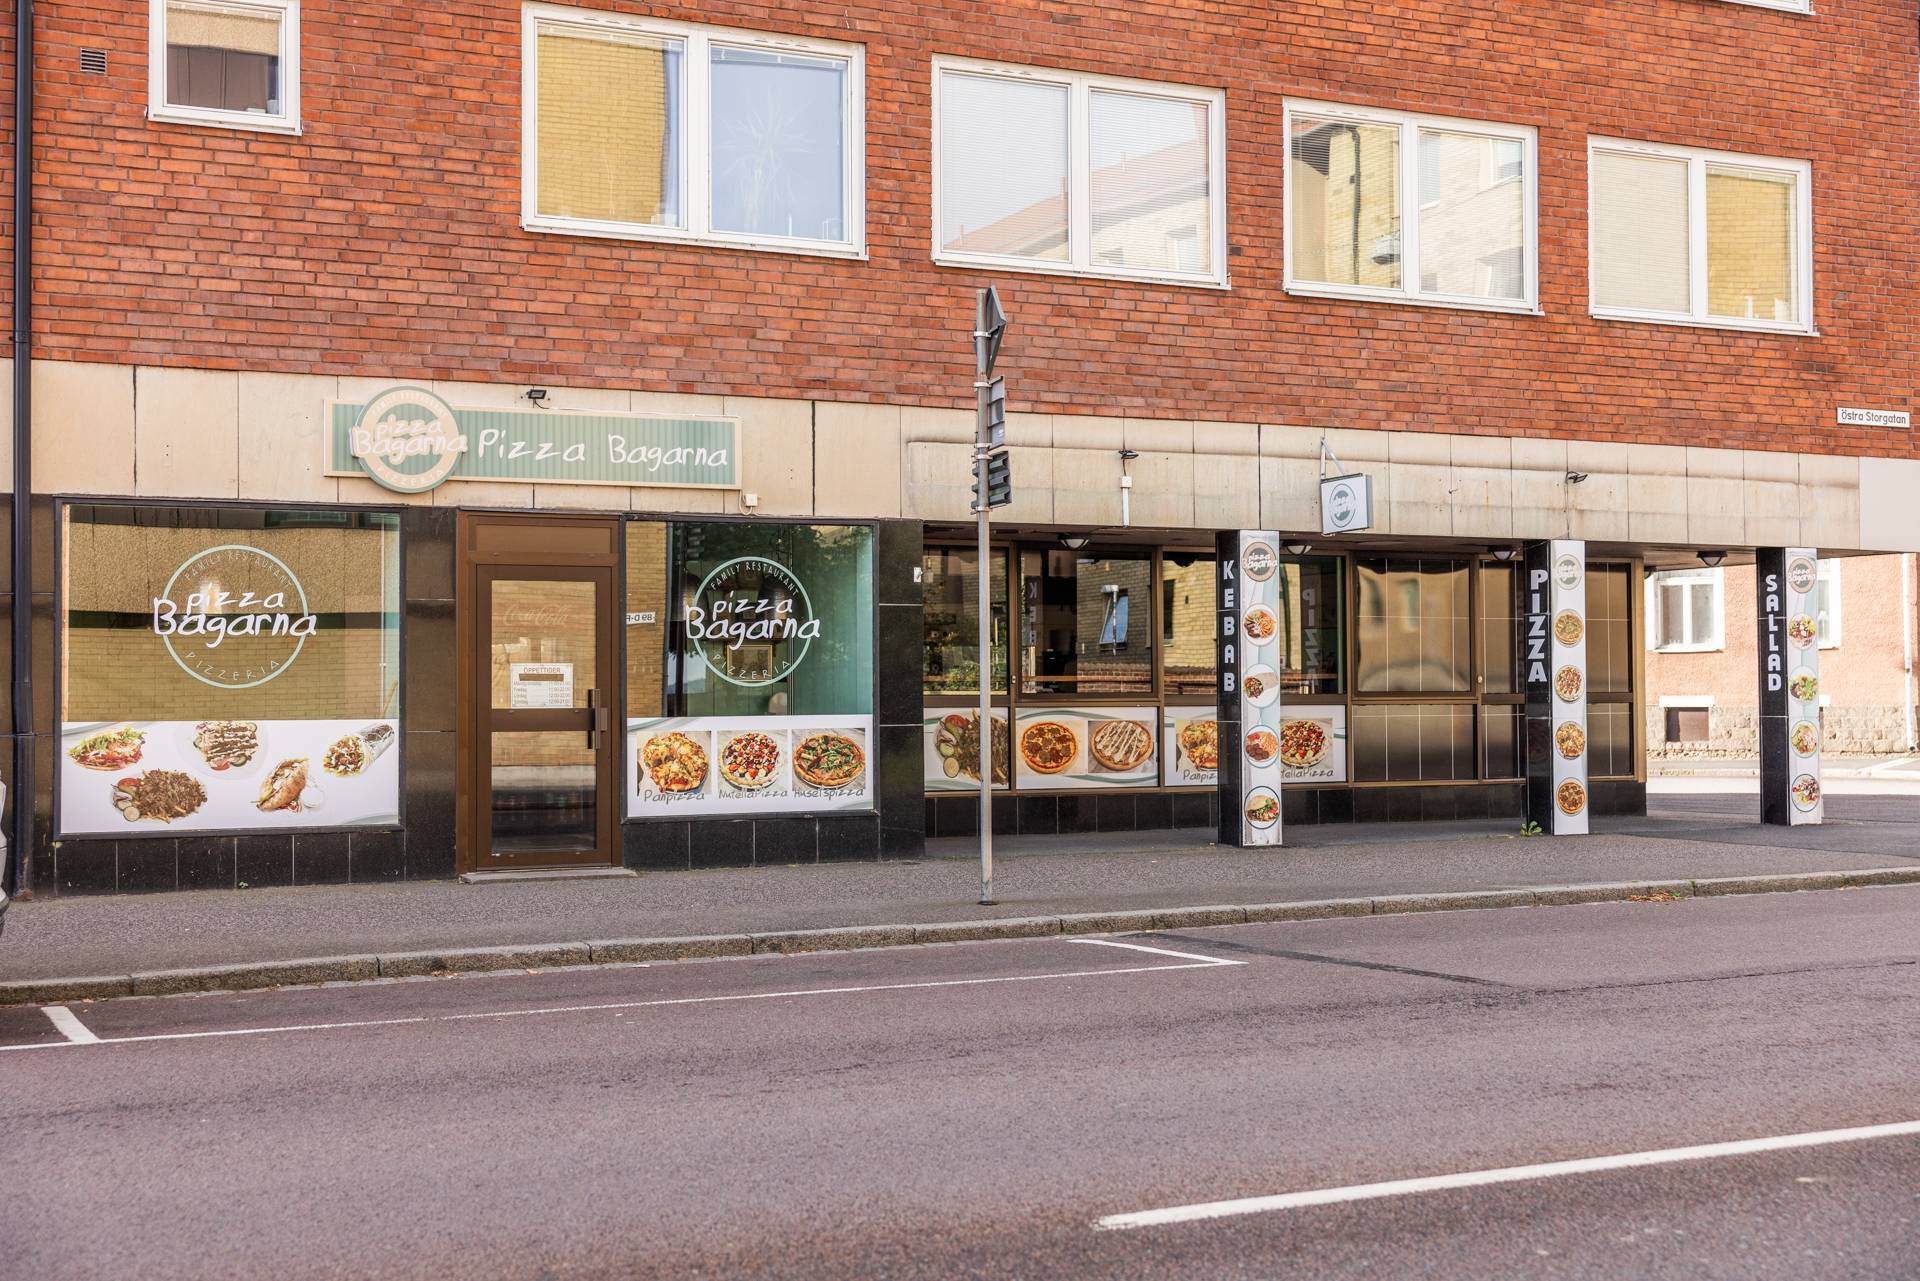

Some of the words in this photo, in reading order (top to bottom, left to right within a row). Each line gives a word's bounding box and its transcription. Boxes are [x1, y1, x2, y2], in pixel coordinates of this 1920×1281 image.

[376, 414, 442, 441] pizza
[1841, 409, 1864, 421] Östra
[1866, 412, 1907, 425] Storgatan
[349, 426, 468, 465] Bagarna
[478, 428, 586, 462] Pizza
[608, 434, 728, 471] Bagarna
[228, 551, 293, 588] RESTAURANT
[711, 564, 740, 590] FAMILY
[745, 561, 799, 596] RESTAURANT
[187, 582, 284, 616] pizza
[712, 590, 793, 621] pizza
[153, 597, 317, 648] Bagarna
[685, 604, 821, 650] Bagarna
[1223, 560, 1235, 692] KEBAB
[1527, 569, 1549, 682] PIZZA
[1765, 574, 1782, 691] SALLAD
[185, 651, 280, 681] PIZZERIA
[712, 653, 791, 680] PIZZERIA
[644, 789, 705, 805] Panpizza
